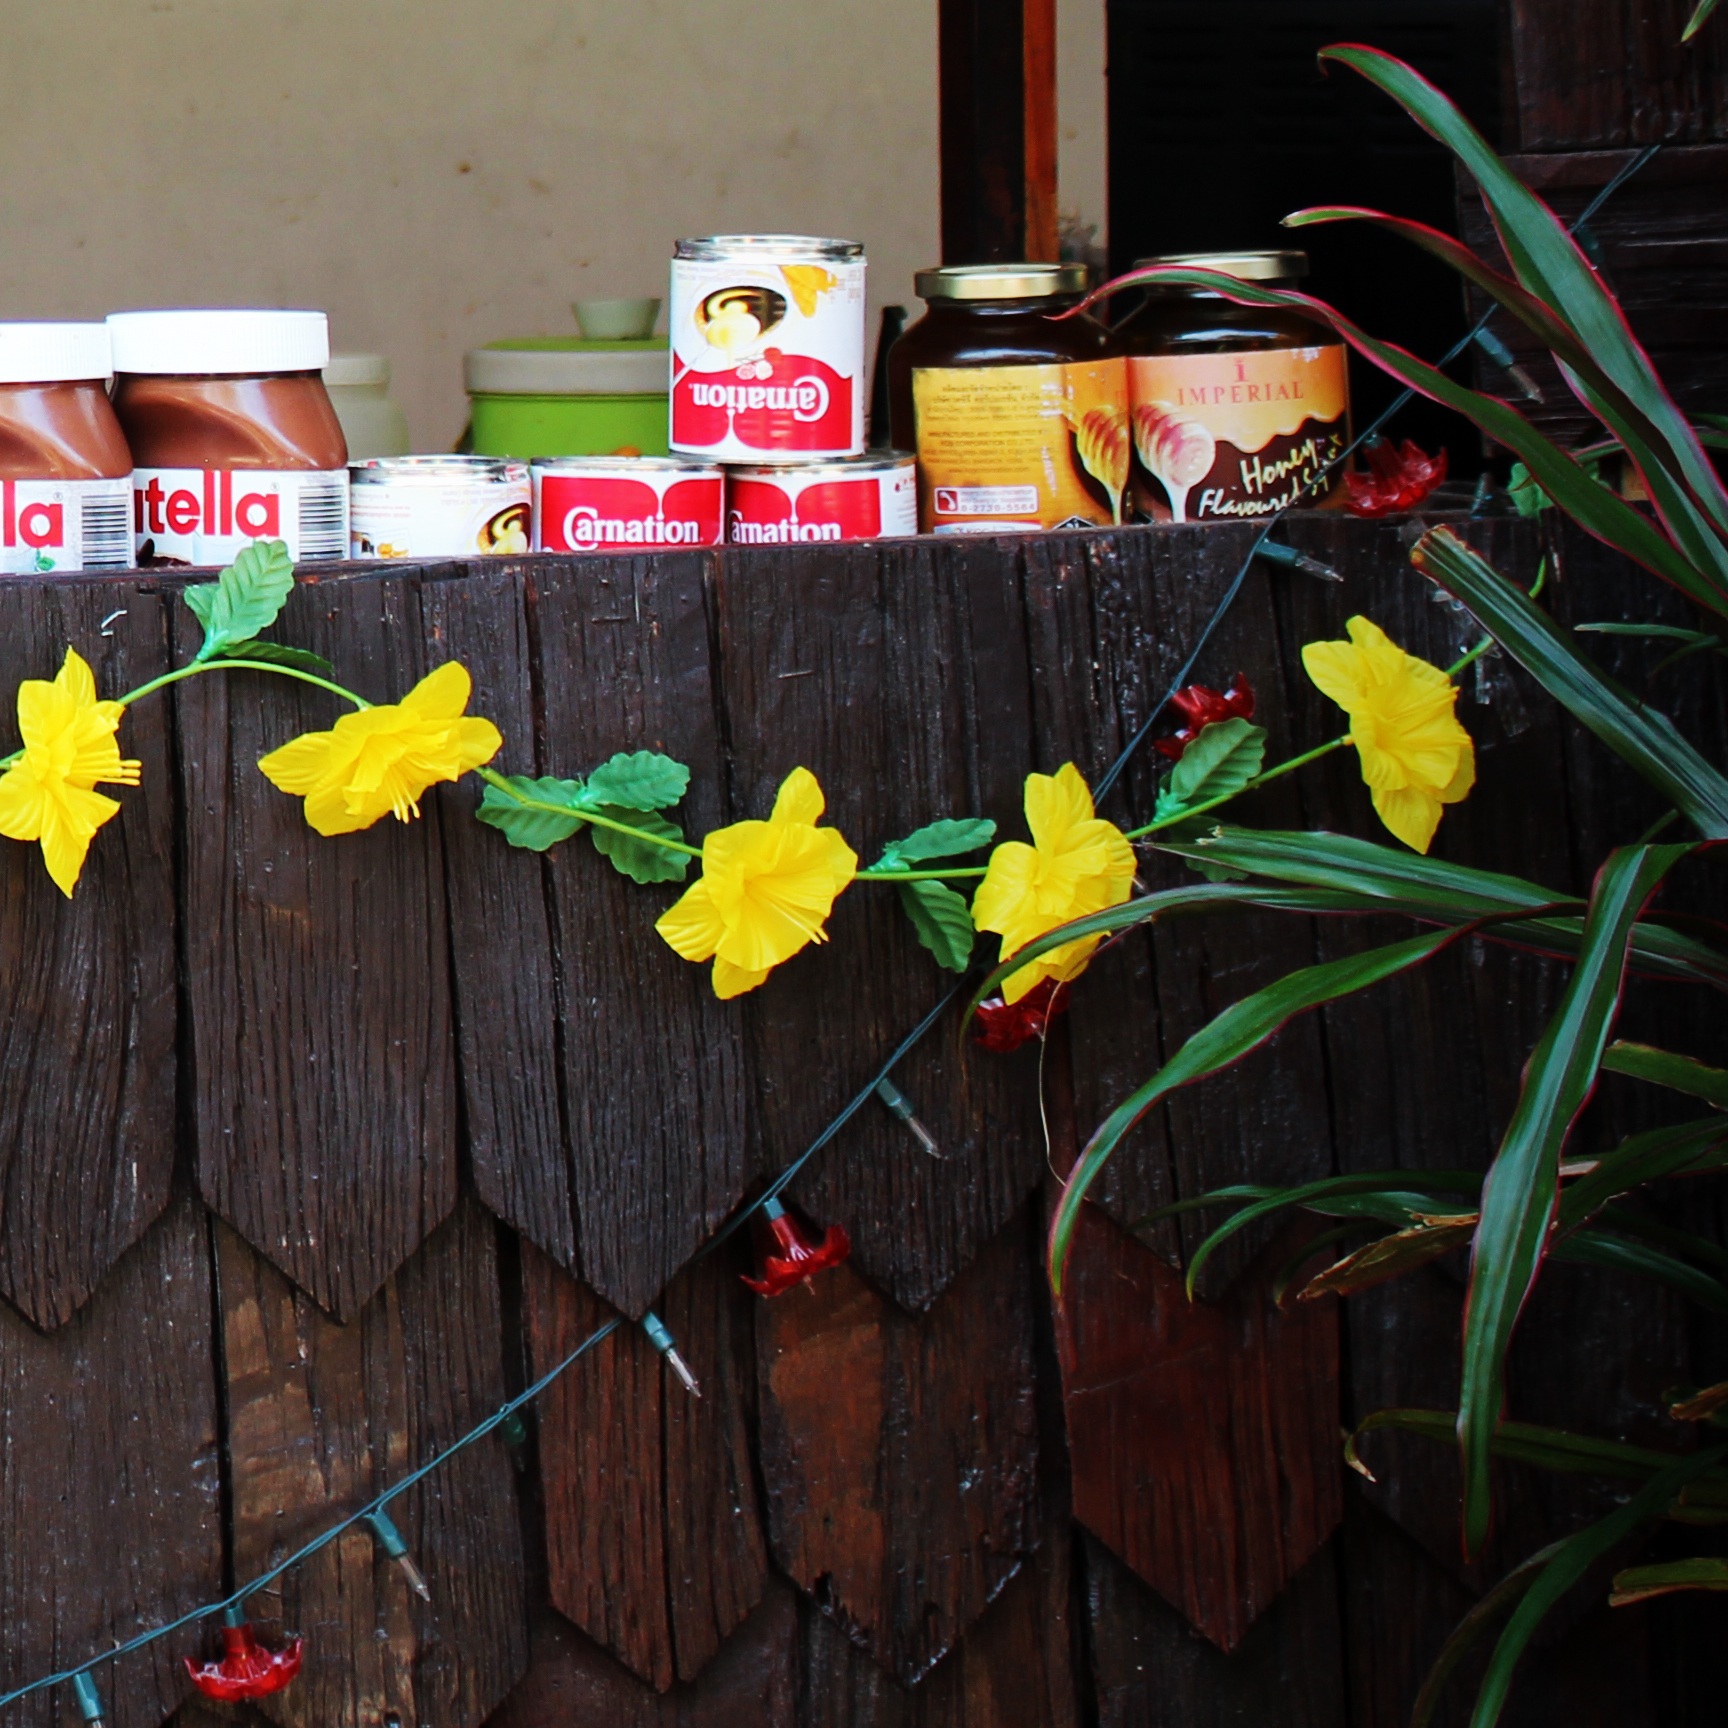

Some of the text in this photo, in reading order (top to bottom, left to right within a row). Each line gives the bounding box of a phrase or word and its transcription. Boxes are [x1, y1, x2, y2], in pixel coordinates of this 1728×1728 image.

[694, 375, 829, 422] Carnation
[1178, 381, 1304, 406] IMPERIAL
[1240, 438, 1318, 495] Honey
[563, 506, 699, 552] Carnation
